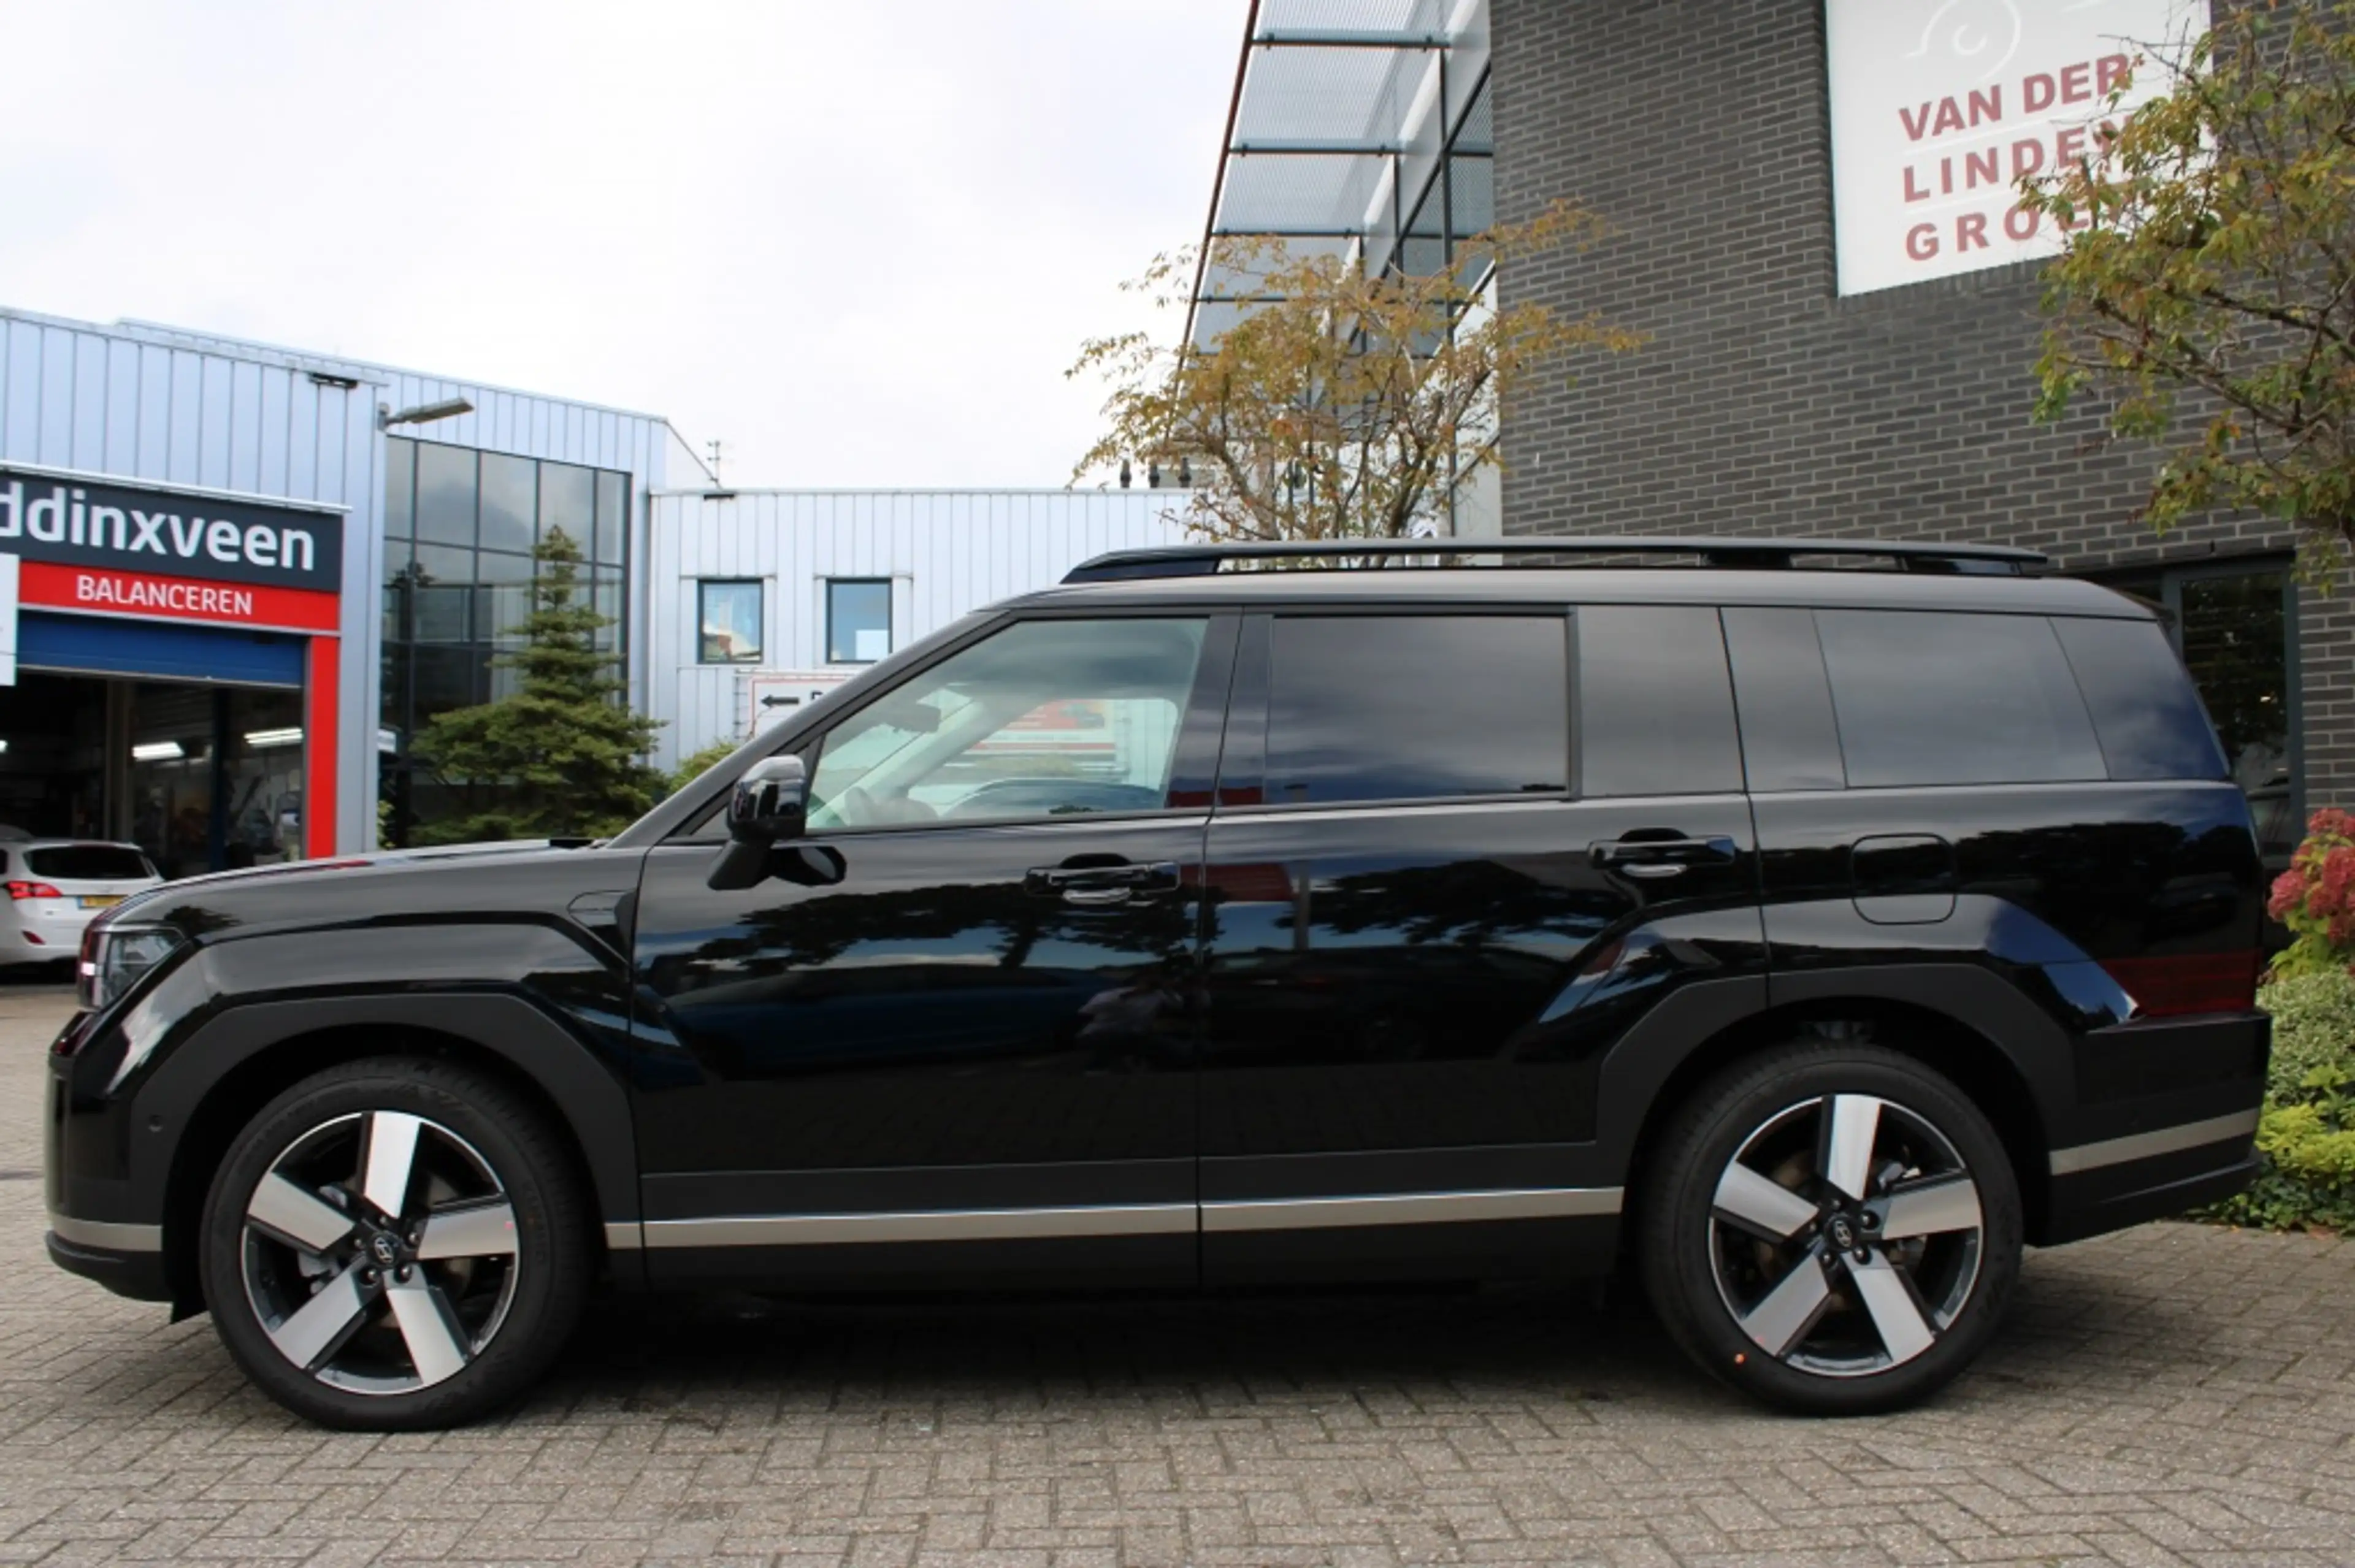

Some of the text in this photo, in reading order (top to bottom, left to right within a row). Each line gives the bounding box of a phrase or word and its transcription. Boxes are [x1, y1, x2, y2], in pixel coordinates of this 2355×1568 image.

[1898, 53, 2129, 141] VAN DER
[1905, 189, 2135, 262] GROE
[77, 575, 252, 616] BALANCEREN
